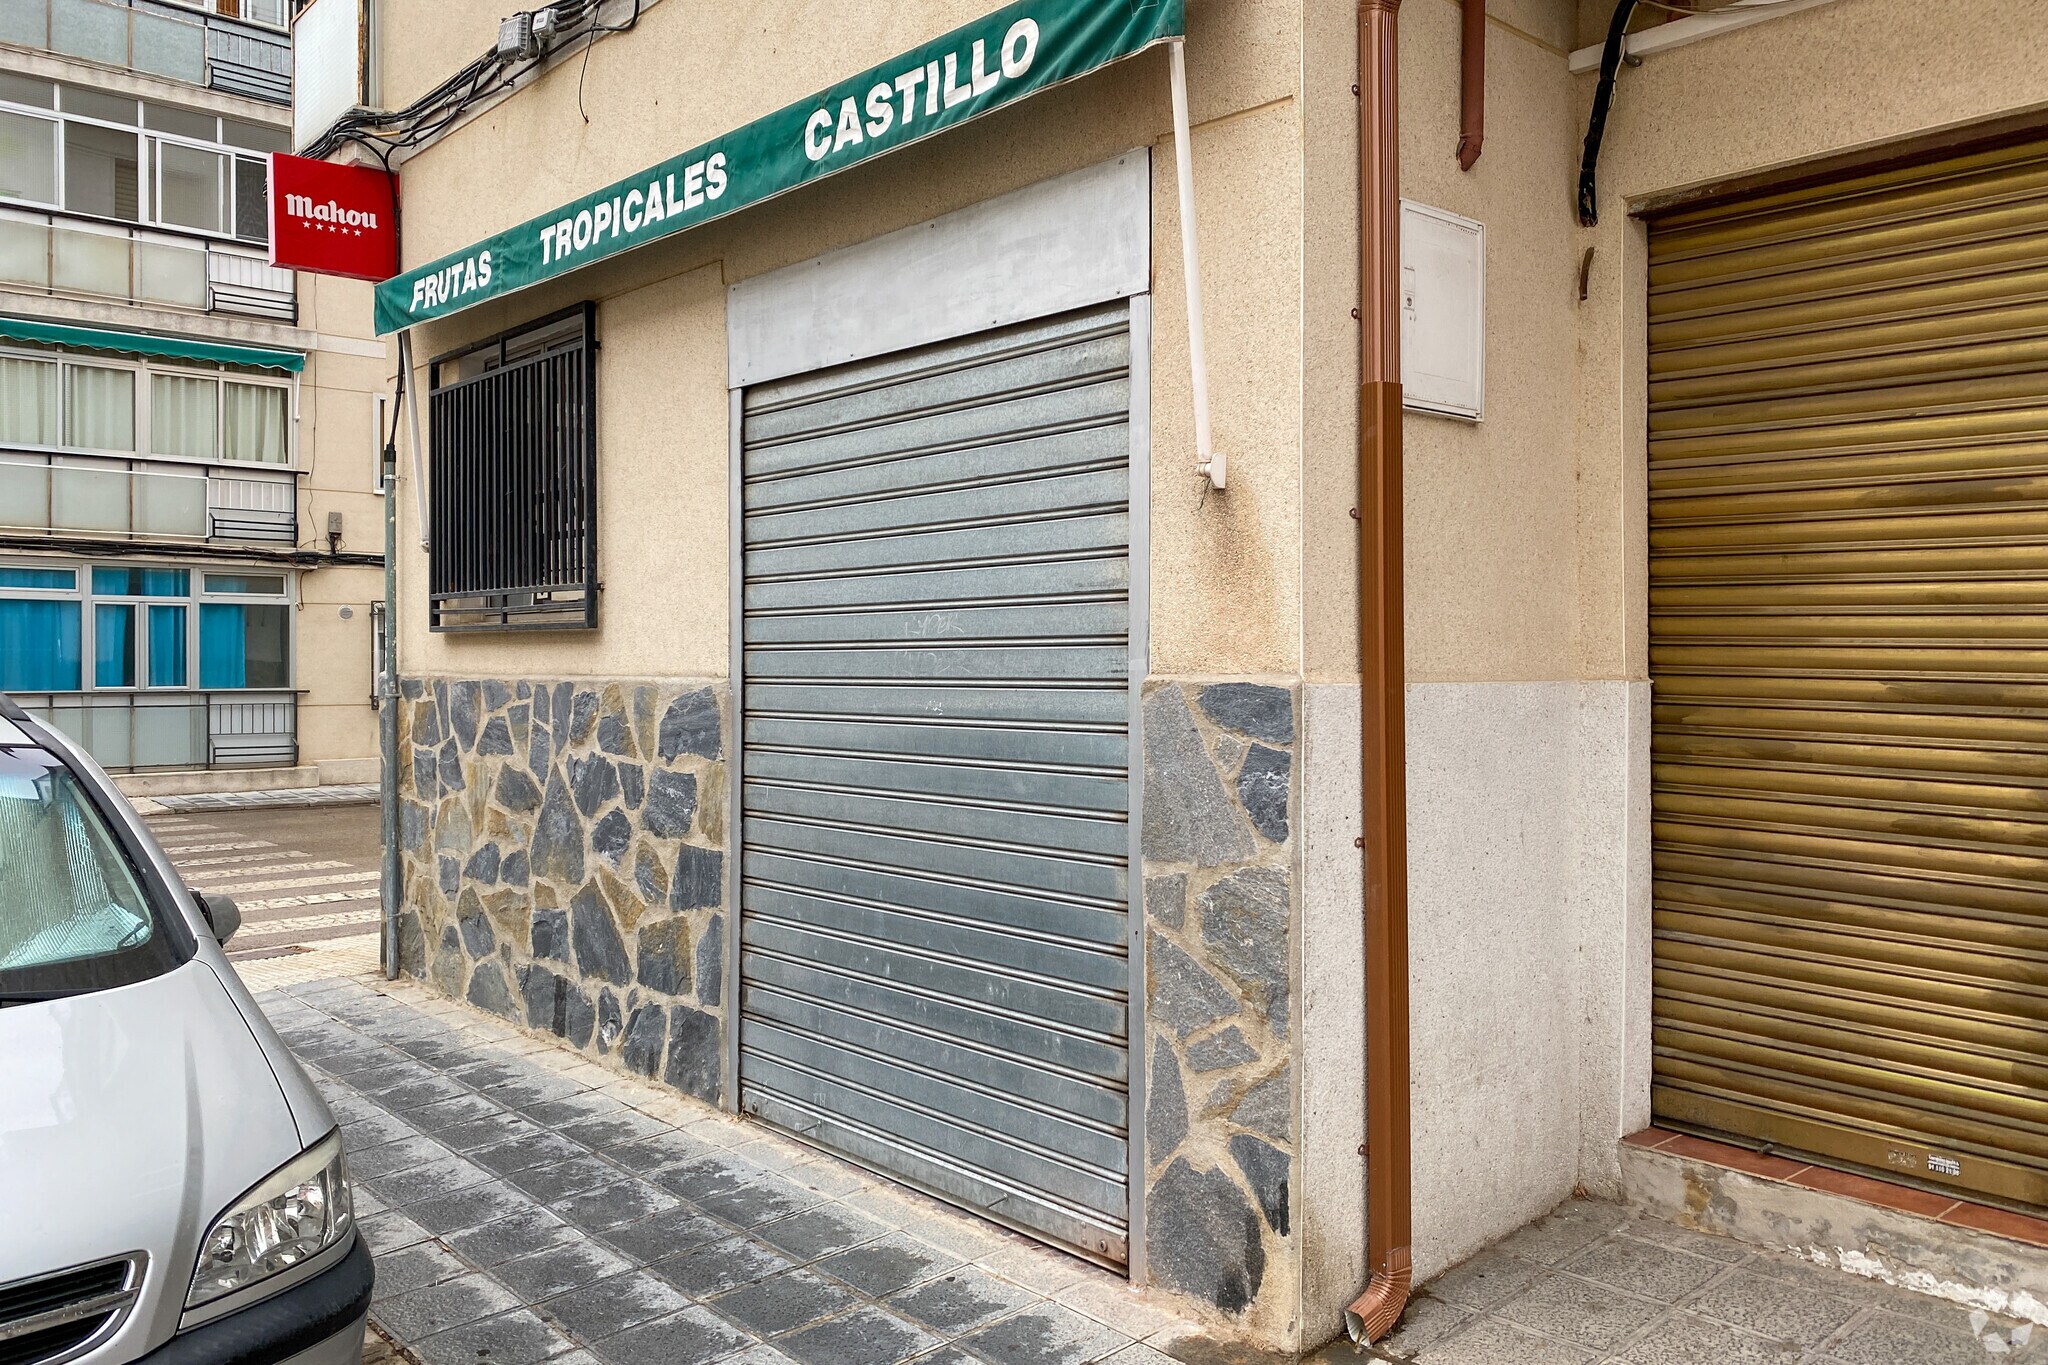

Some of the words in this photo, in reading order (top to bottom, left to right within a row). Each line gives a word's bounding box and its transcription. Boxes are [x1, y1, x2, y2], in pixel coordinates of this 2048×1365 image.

[284, 193, 378, 229] Mahou
[409, 250, 492, 313] FRUTAS
[540, 152, 727, 265] TROPICALES
[804, 18, 1040, 161] CASTILLO
